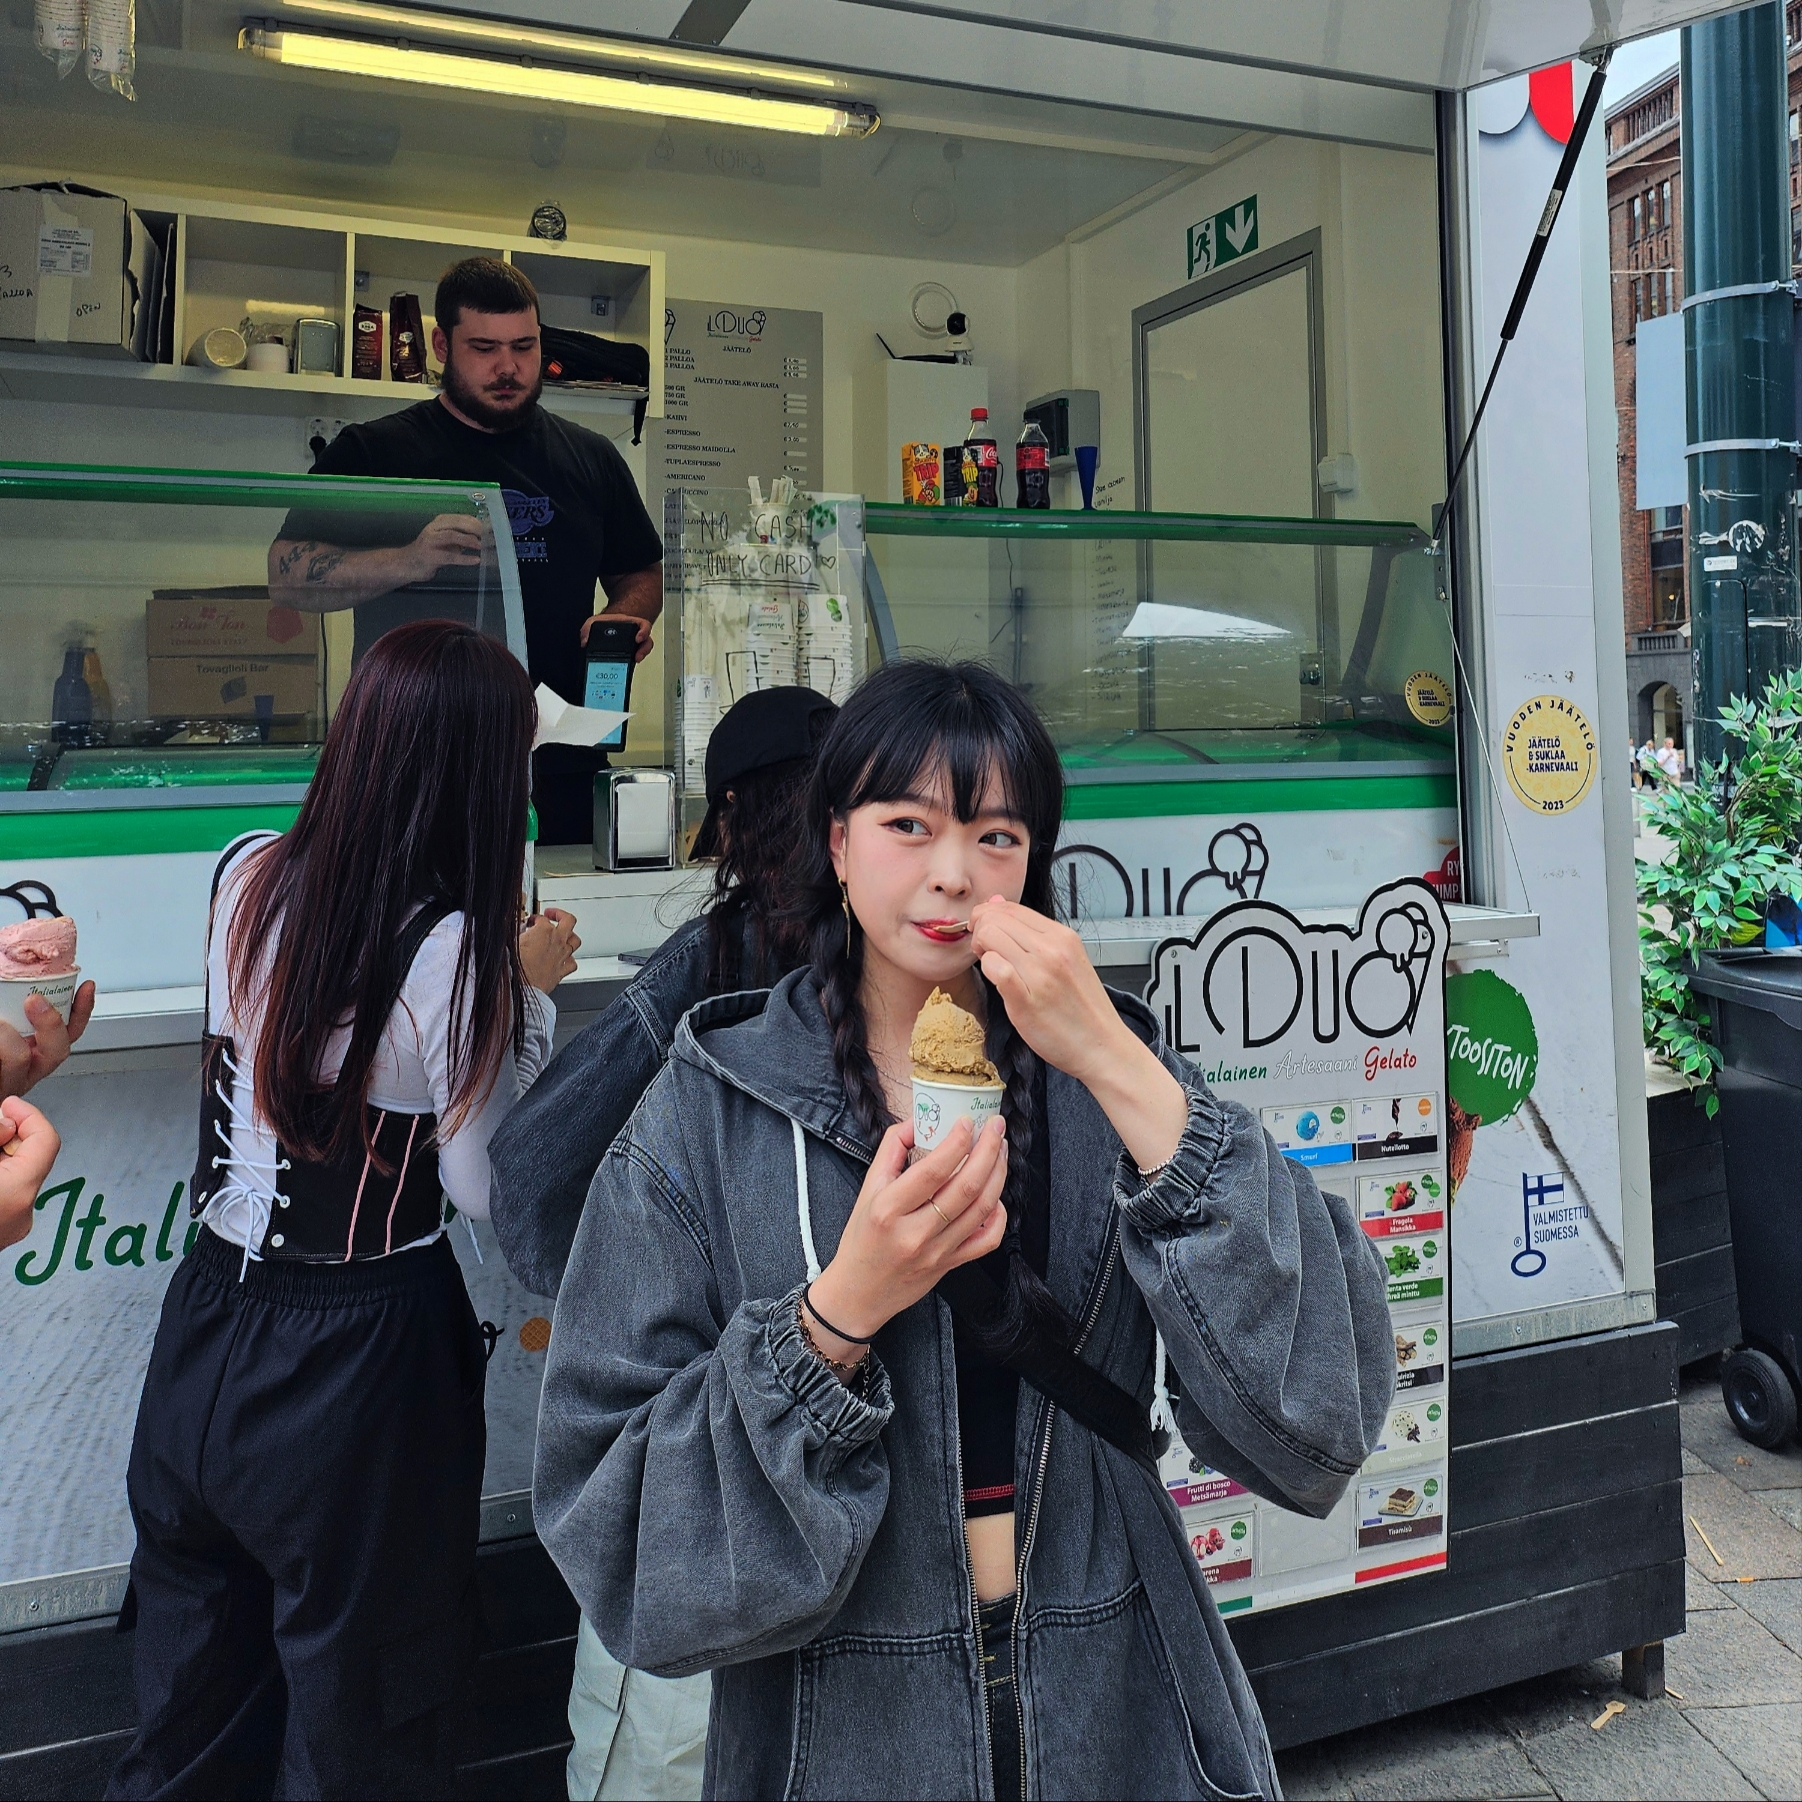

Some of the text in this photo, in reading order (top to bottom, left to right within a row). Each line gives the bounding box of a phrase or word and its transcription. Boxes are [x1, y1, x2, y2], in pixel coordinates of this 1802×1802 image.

[669, 355, 695, 363] PALLOA
[742, 380, 760, 388] AWAY
[913, 463, 940, 481] TRIP
[961, 465, 979, 483] TRIP
[700, 511, 813, 544] NO CASH
[707, 552, 812, 578] ONLY CARD
[196, 664, 269, 675] Tovaglioli Bar
[1506, 699, 1596, 753] VUODEN JÄÄTELÖ
[1527, 736, 1561, 749] JÄÄTELÖ
[1535, 750, 1566, 761] SUKLAA
[1542, 800, 1564, 811] 2023
[1447, 860, 1460, 877] RY
[1446, 1024, 1529, 1090] TOOSITON
[1200, 1045, 1418, 1085] alainen Artesaani Gelato
[1392, 1218, 1413, 1226] Fragola
[1533, 1204, 1589, 1227] VALMISTETTU
[1389, 1224, 1416, 1234] Mansikka
[1534, 1224, 1580, 1244] SUOMESSA
[1402, 1282, 1419, 1291] verde
[1386, 1290, 1420, 1300] hreä minttu
[1187, 1485, 1205, 1494] Frutti
[1212, 1481, 1231, 1490] bosco
[1191, 1489, 1228, 1502] Metsämarja
